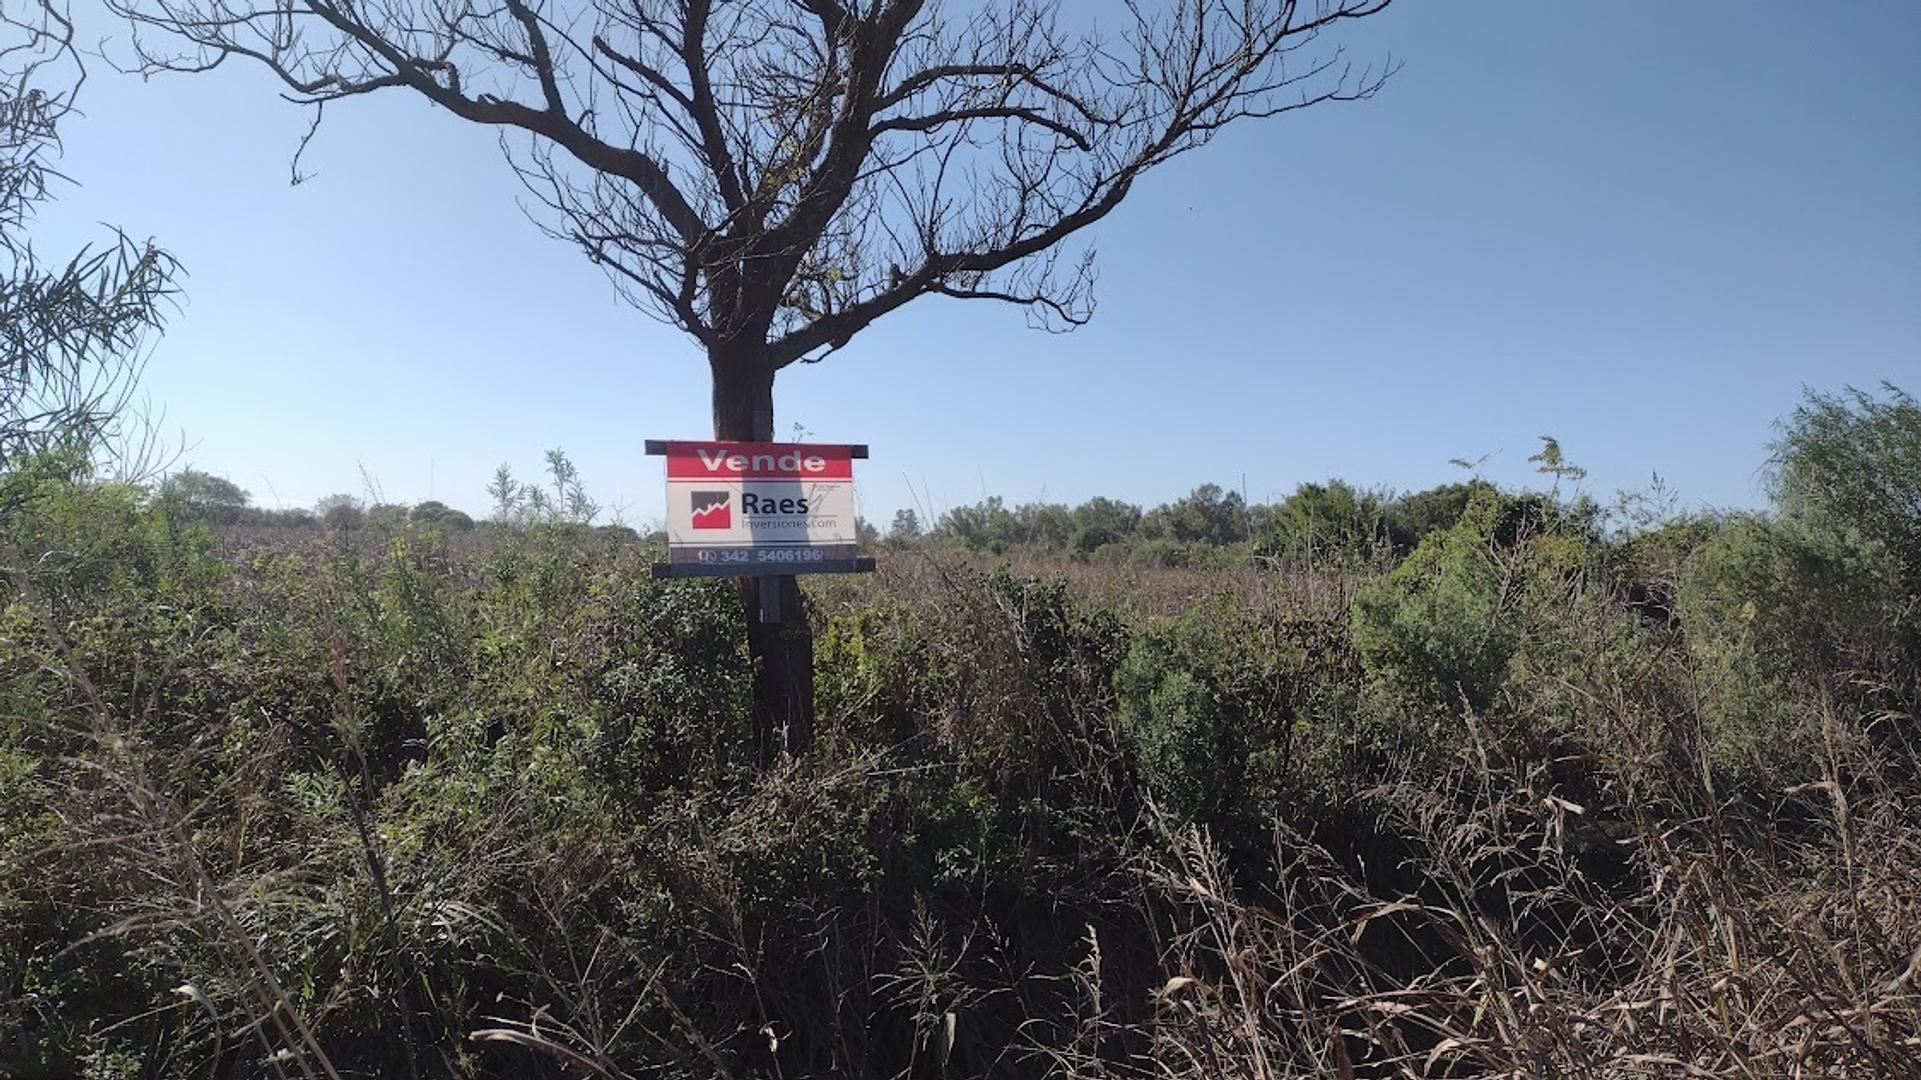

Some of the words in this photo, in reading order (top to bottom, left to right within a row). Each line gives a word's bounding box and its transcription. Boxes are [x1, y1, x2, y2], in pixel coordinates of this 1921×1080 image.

[697, 449, 827, 472] Vende
[742, 493, 809, 515] Raes
[721, 549, 749, 562] 342
[758, 549, 821, 562] 5406196
